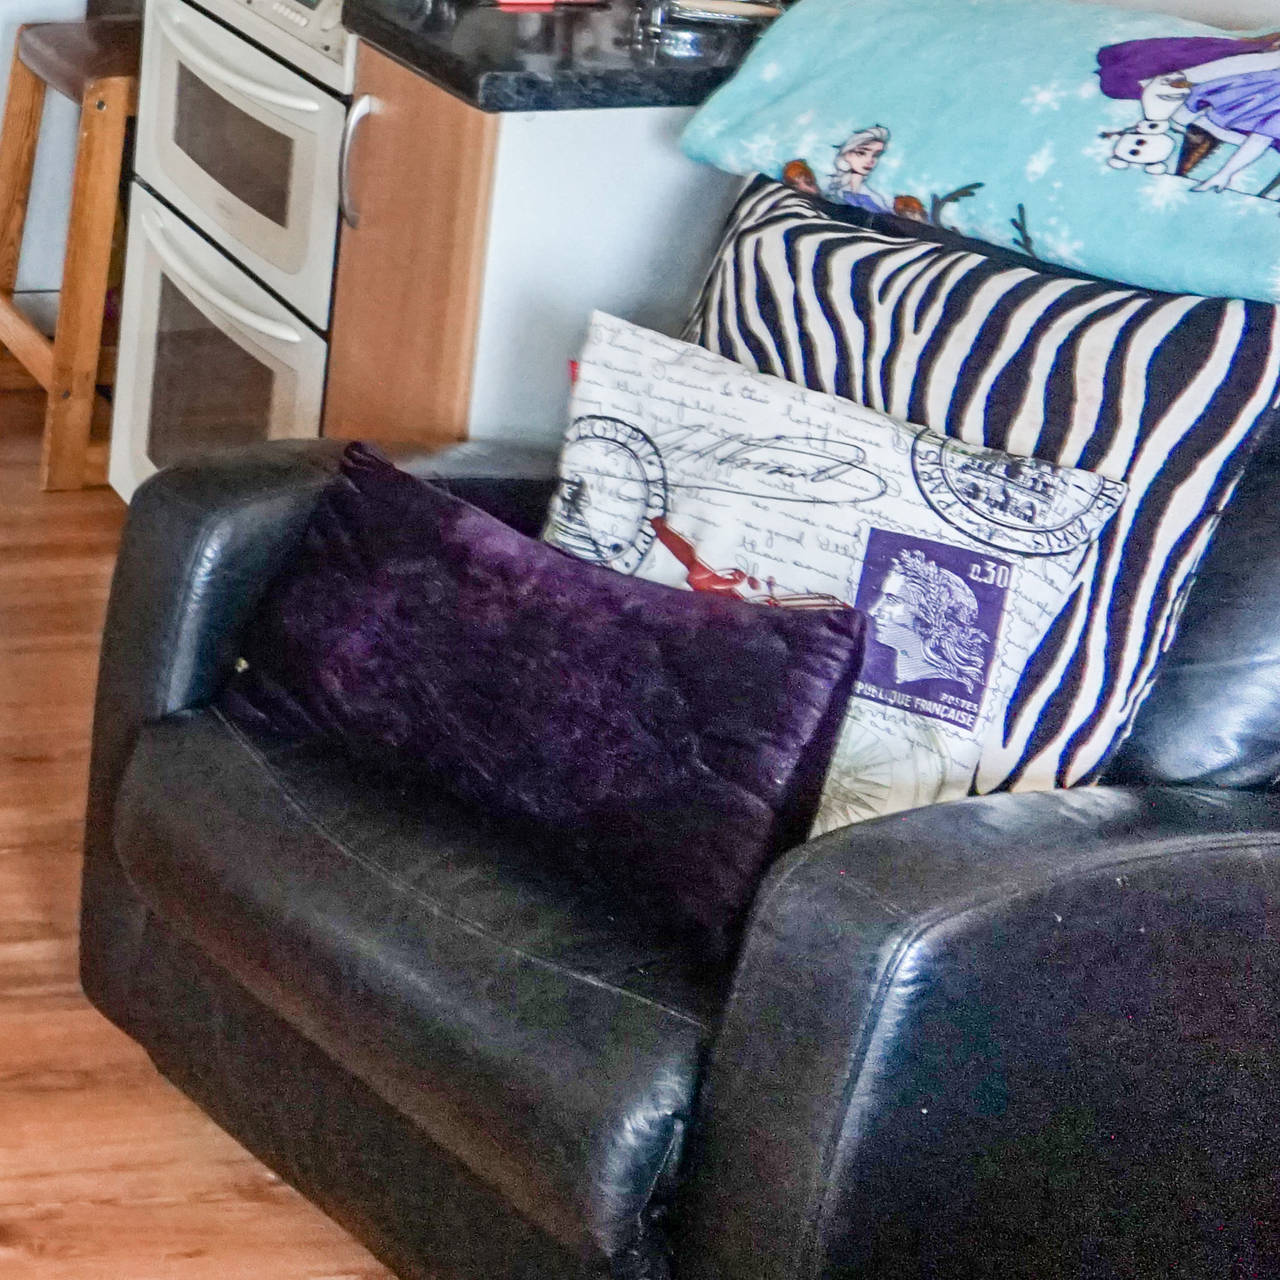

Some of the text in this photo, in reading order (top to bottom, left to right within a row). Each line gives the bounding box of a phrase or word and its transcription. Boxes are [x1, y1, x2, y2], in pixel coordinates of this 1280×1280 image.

[968, 559, 1010, 588] 0.30
[853, 680, 913, 709] PUBLIQUE
[939, 692, 979, 713] POSTES
